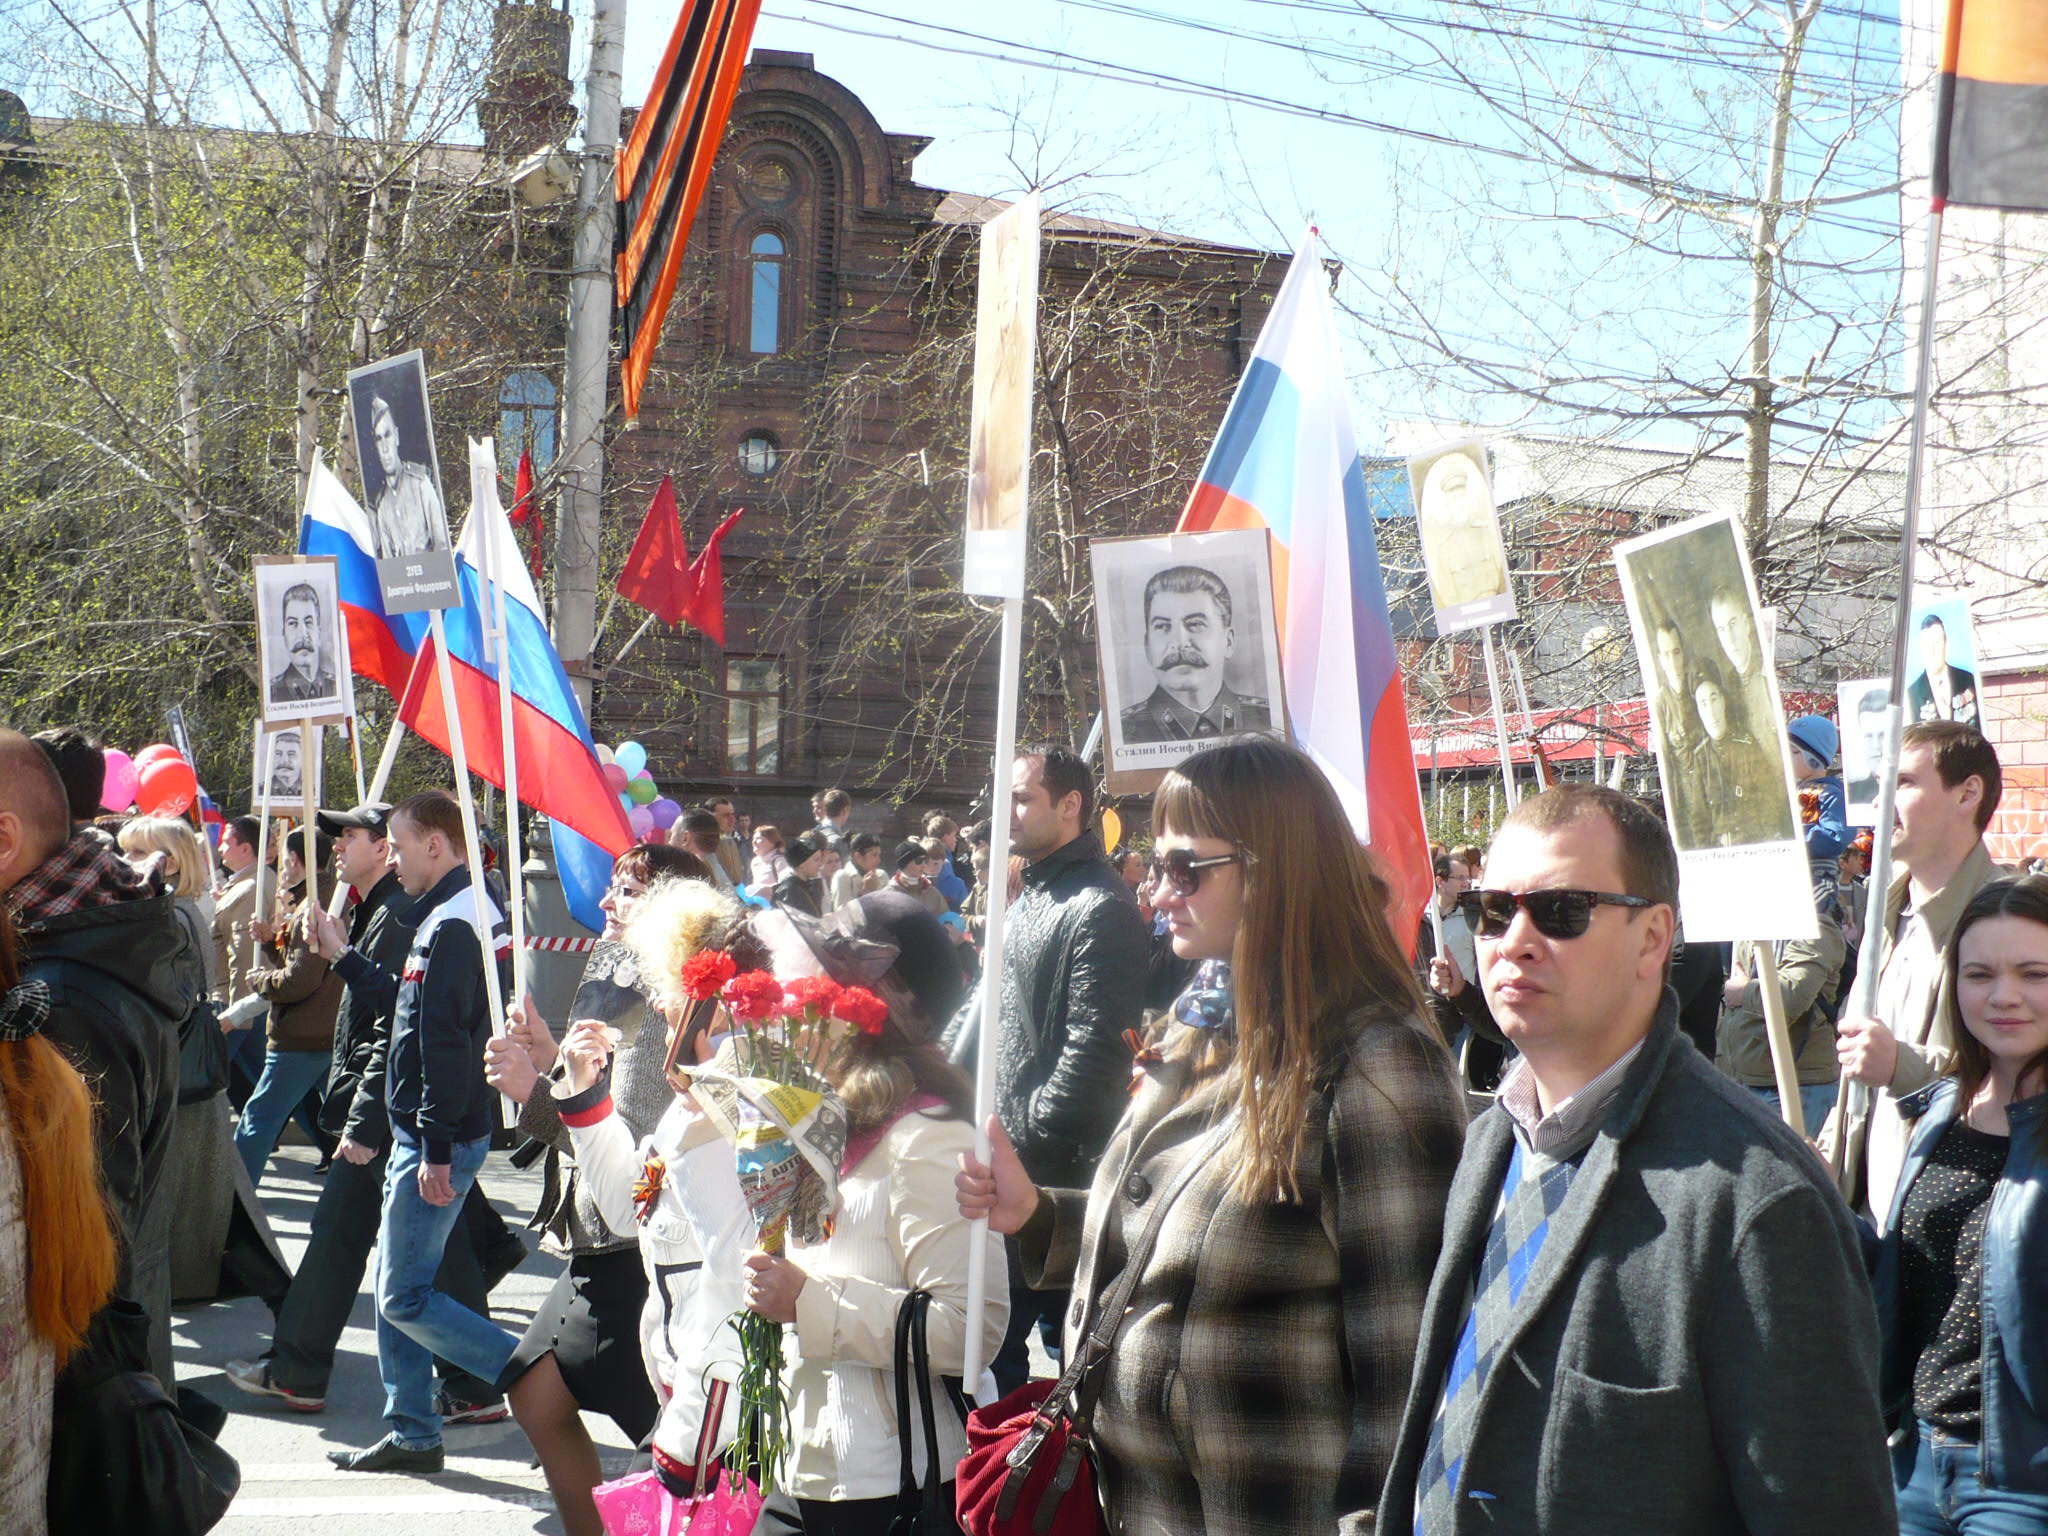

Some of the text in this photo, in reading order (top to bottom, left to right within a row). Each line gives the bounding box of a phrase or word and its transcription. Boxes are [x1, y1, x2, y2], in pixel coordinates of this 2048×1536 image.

[266, 704, 289, 712] Сталин
[1115, 745, 1156, 758] Сталин
[1158, 744, 1195, 755] Иосиф
